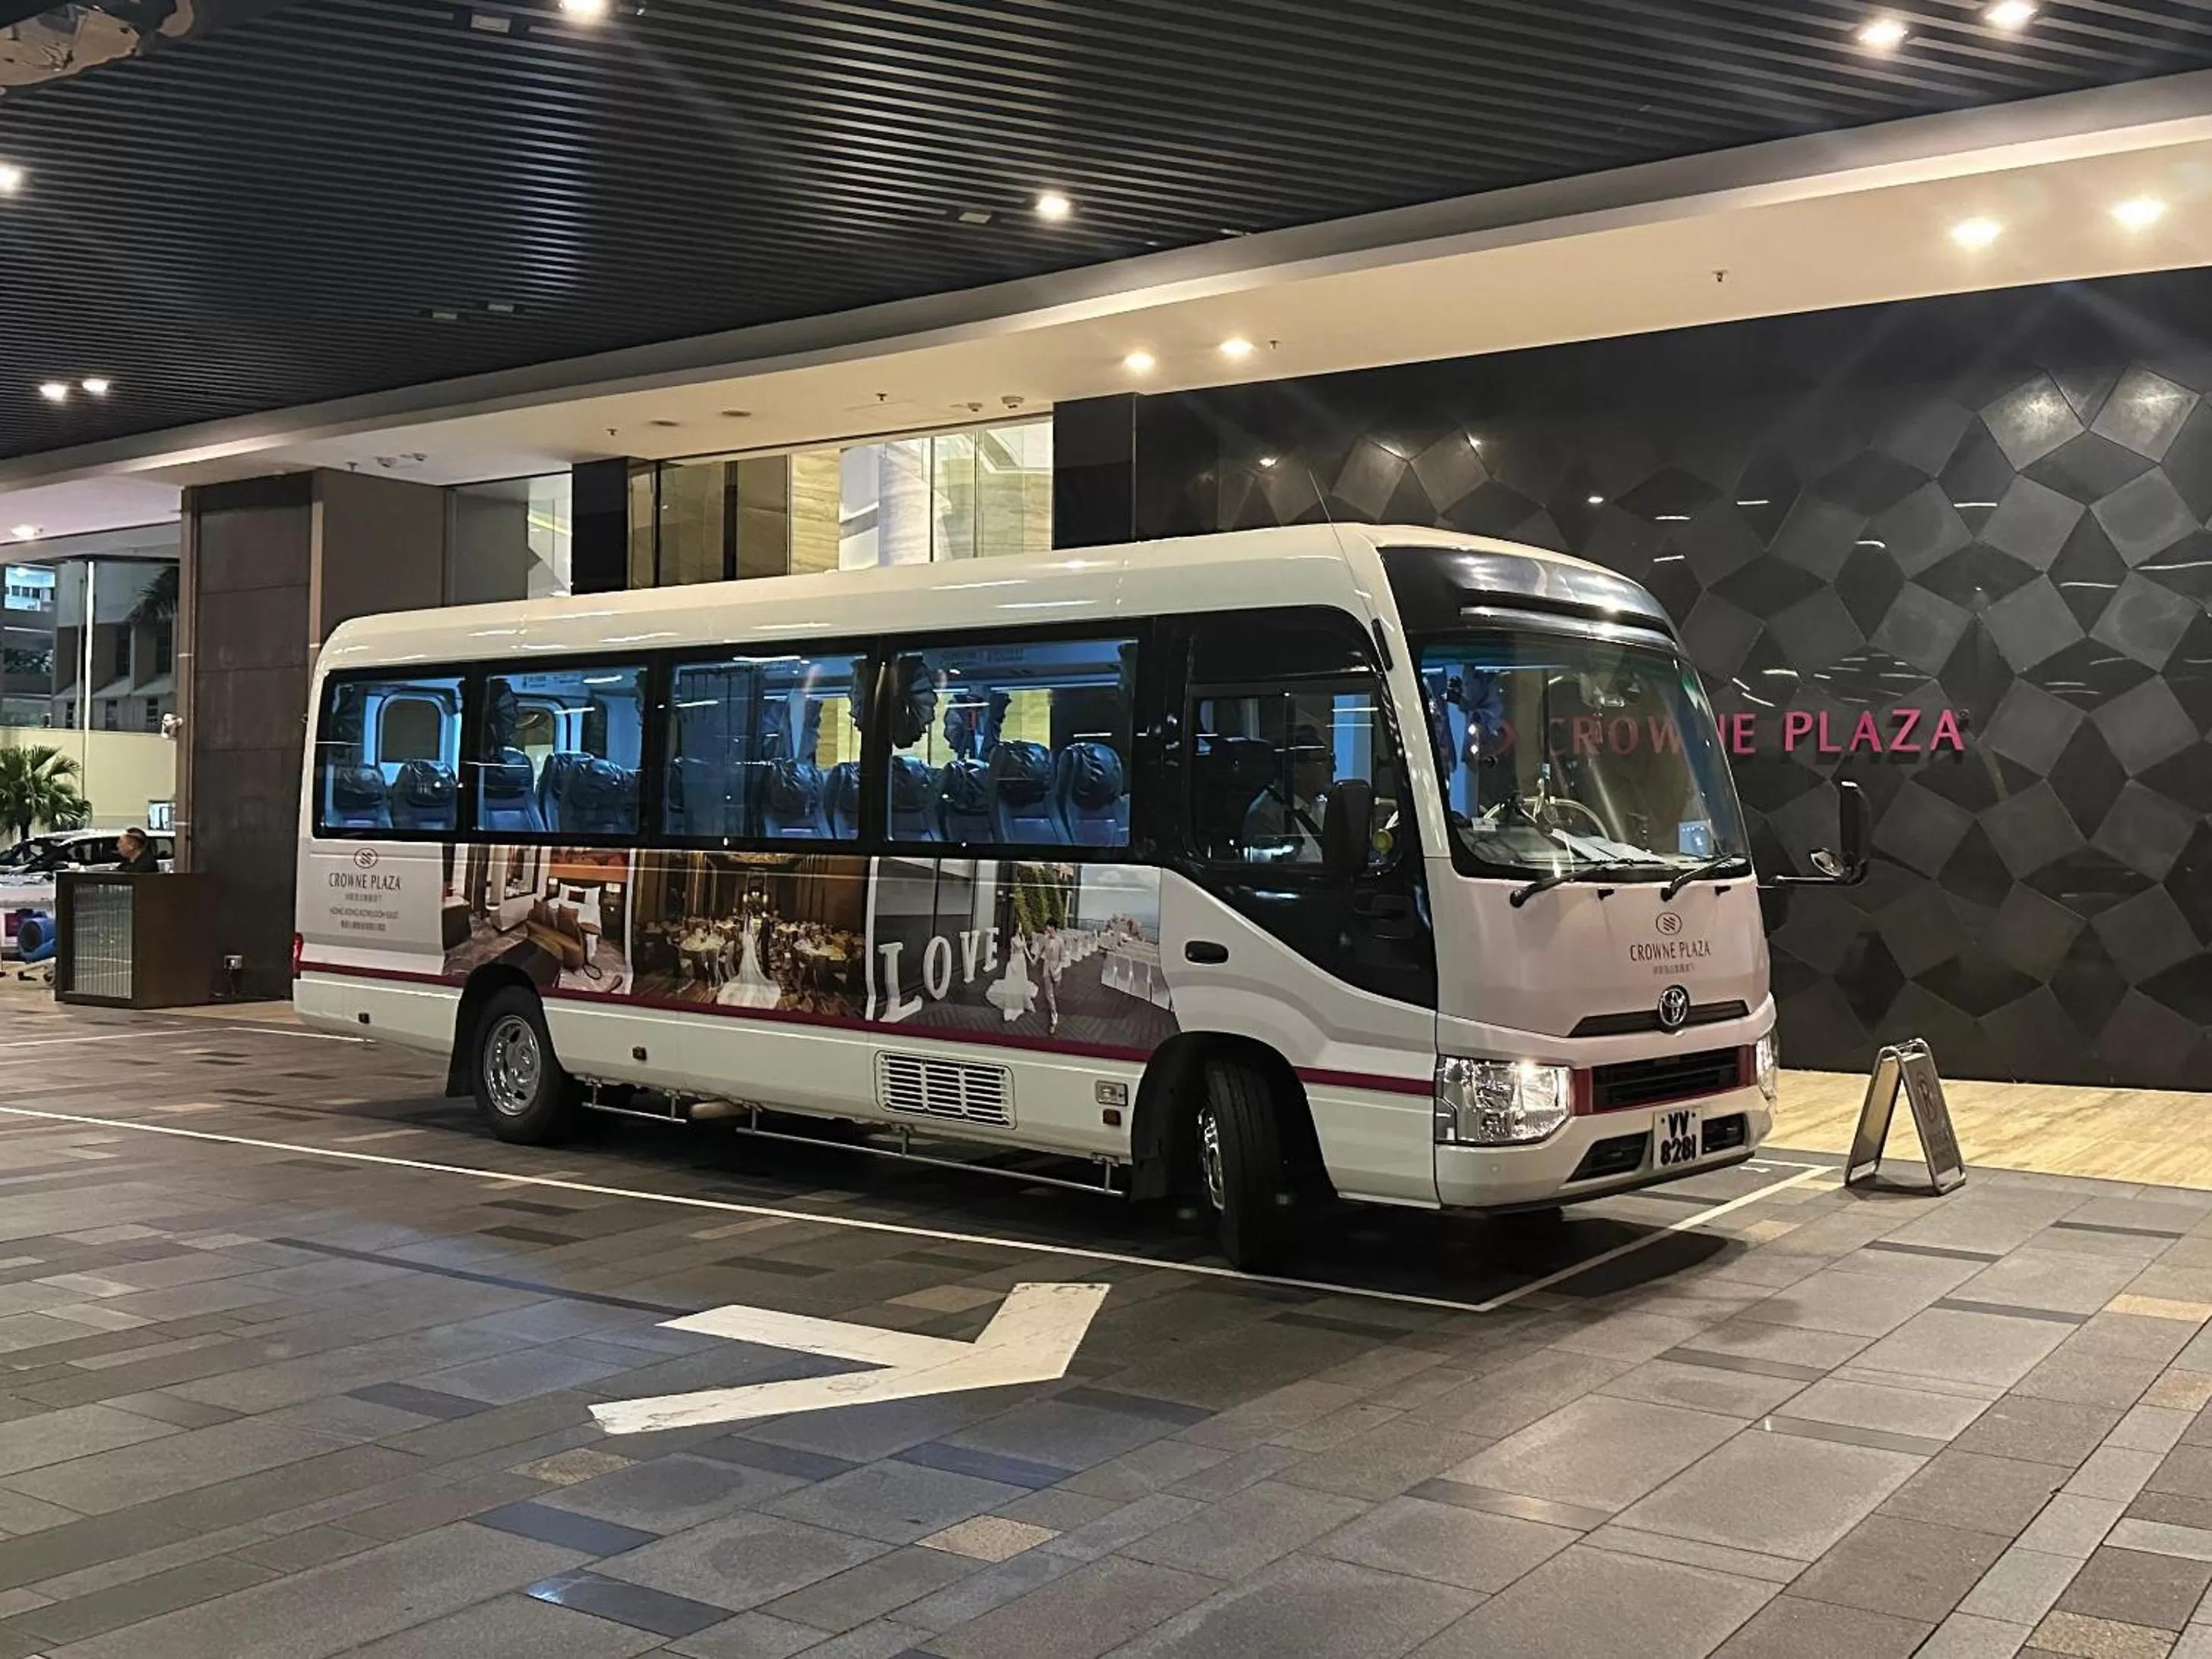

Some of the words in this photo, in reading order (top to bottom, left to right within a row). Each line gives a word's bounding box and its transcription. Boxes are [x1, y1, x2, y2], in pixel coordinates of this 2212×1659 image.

[1541, 713, 1757, 755] CROWE
[1785, 708, 1964, 753] PLAZA
[329, 872, 367, 888] CROWNE
[371, 875, 401, 891] PLAZA
[1630, 942, 1677, 961] CROWNE
[1679, 940, 1711, 959] PLAZA
[878, 927, 1000, 1023] LOVE
[1660, 1134, 1697, 1165] 8281
